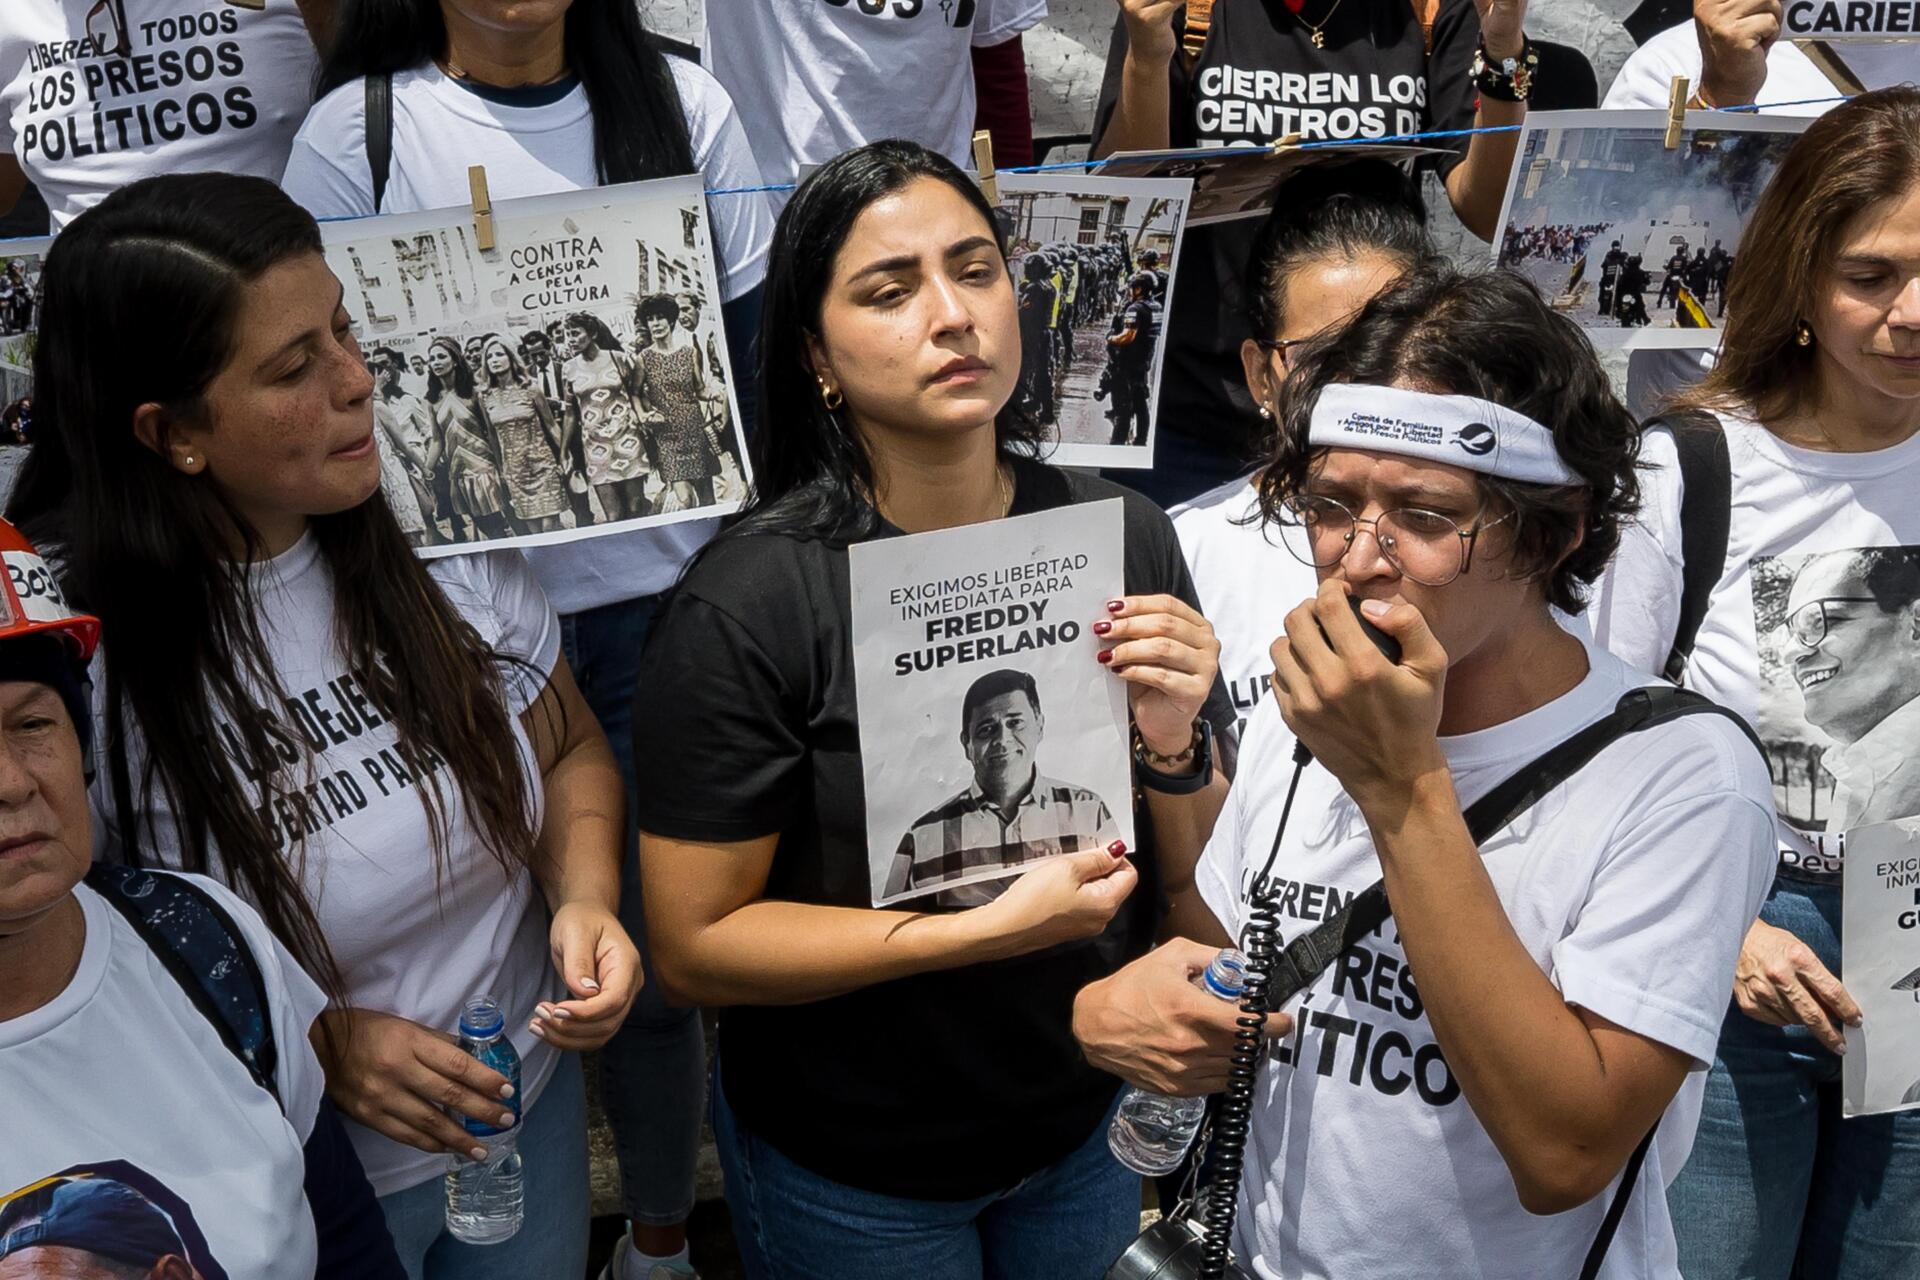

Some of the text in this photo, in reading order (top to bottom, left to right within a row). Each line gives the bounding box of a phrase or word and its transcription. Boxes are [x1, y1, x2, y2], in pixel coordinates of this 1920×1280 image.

[140, 9, 238, 46] TODOS
[1787, 1, 1920, 33] CARIE
[29, 41, 244, 114] LOS PRESOS
[1200, 64, 1427, 108] CIERREN LOS
[23, 86, 257, 164] POLÍTICOS
[1196, 99, 1386, 140] CENTROS
[509, 257, 599, 286] A CENSURA
[510, 236, 603, 269] CONTRA
[522, 284, 610, 310] CULTURA
[546, 273, 583, 289] PELA
[1344, 418, 1374, 428] Amigos
[1376, 423, 1390, 431] por
[1393, 425, 1401, 433] la
[1404, 427, 1443, 439] Libertad
[1352, 412, 1443, 432] Comité de Familiares
[1356, 426, 1367, 434] los
[1370, 427, 1399, 439] Presos
[890, 554, 1088, 605] EXIGIMOS LIBERTAD
[902, 575, 1073, 621] INMEDIATA PARA
[926, 598, 1049, 642] FREDDY
[895, 620, 1080, 676] SUPERLANO
[286, 672, 395, 754] DEJE
[254, 769, 368, 850] BERTAD
[1877, 857, 1920, 876] EXIG
